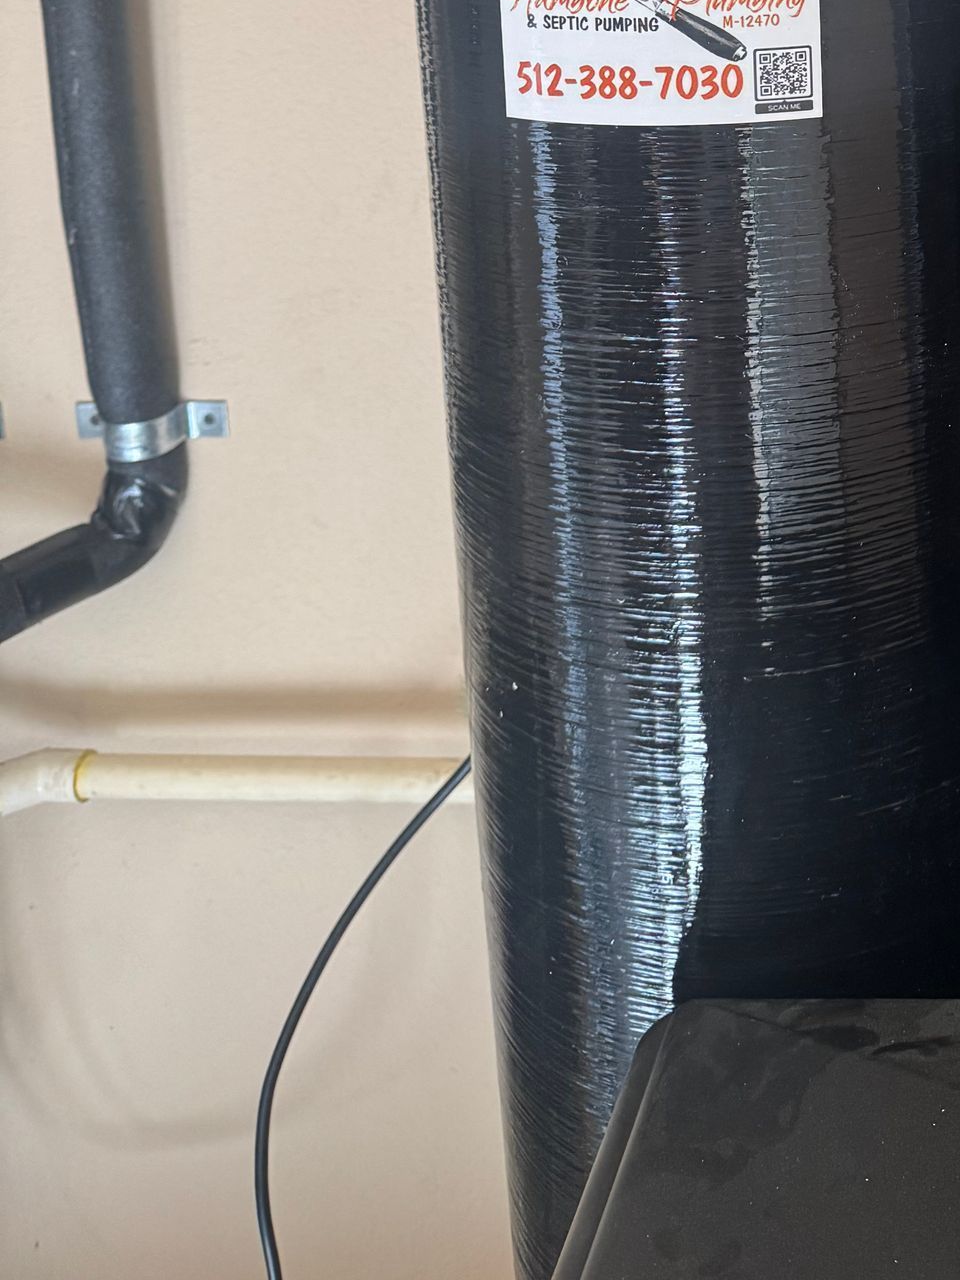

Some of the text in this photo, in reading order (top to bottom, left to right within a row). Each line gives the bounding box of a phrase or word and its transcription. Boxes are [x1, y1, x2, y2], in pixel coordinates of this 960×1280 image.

[526, 13, 660, 33] & SEPTIC PUMPING
[722, 14, 780, 29] M-12470
[517, 61, 744, 100] 512-388-7030
[767, 102, 802, 112] SCAN ME
